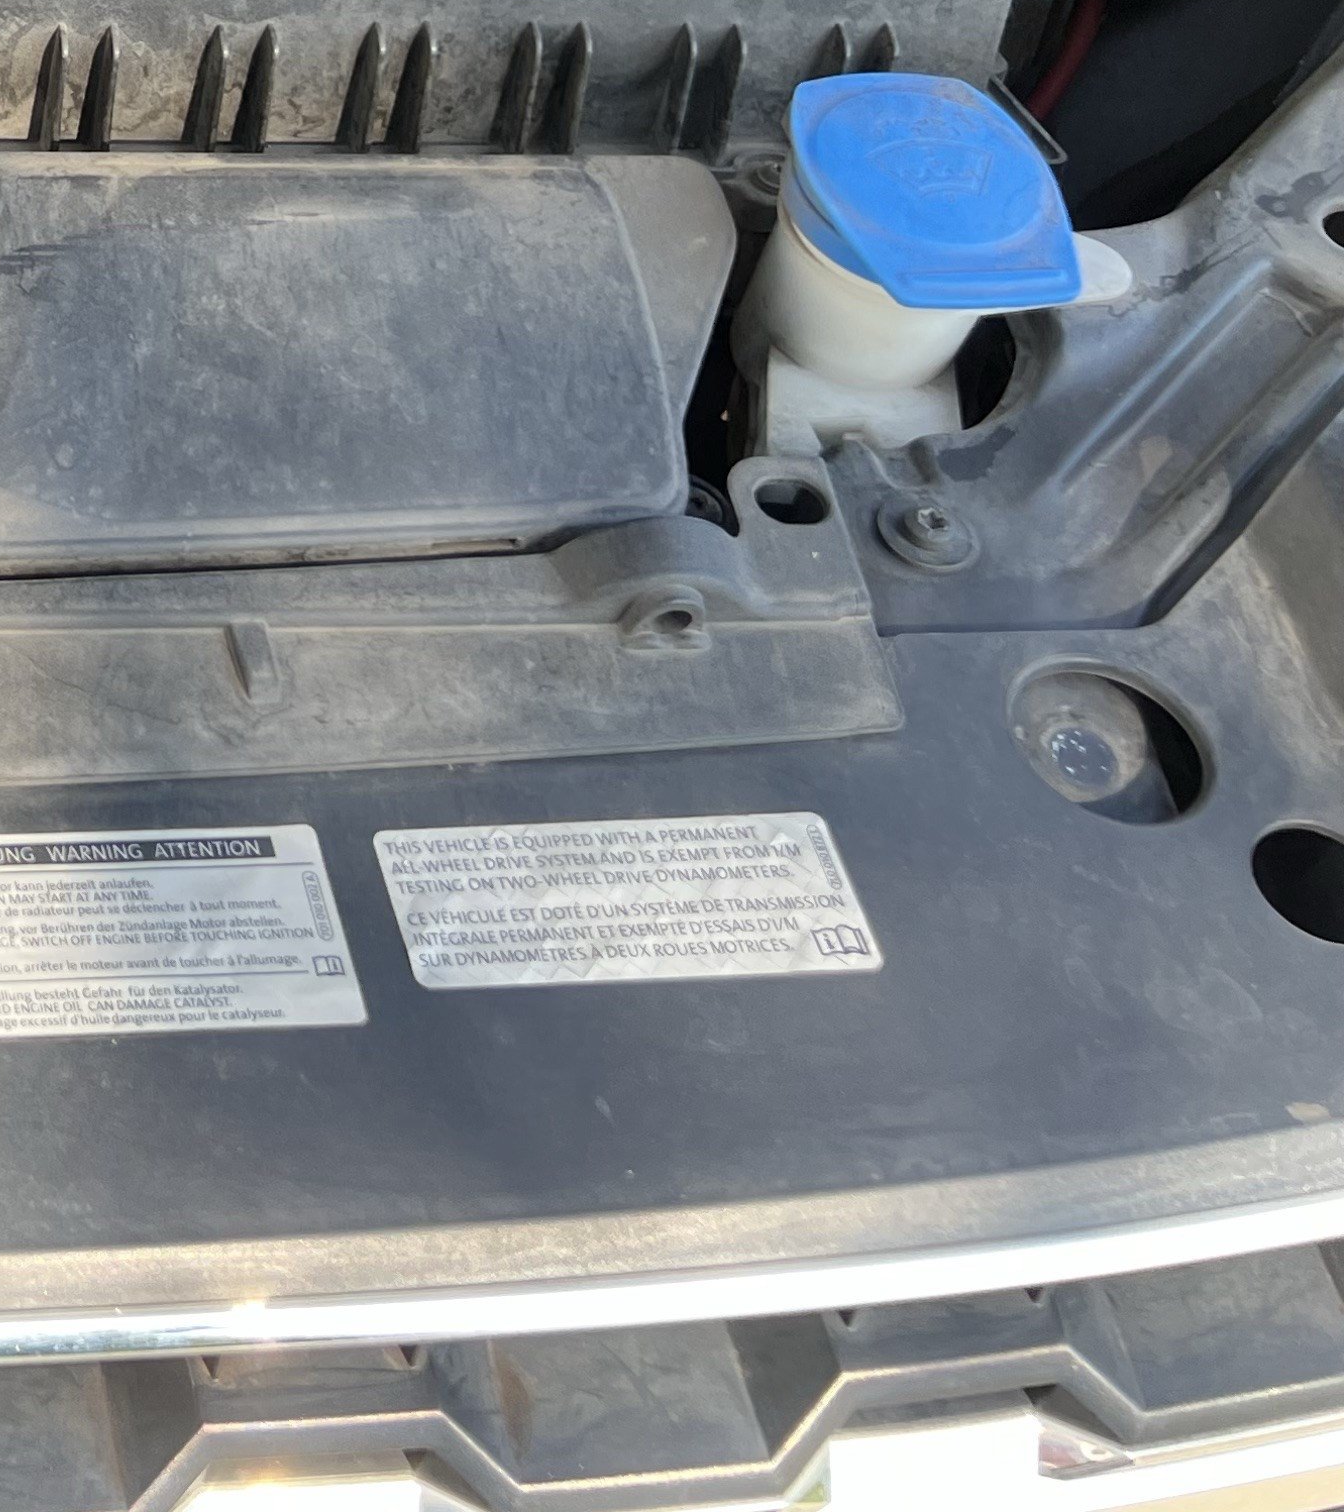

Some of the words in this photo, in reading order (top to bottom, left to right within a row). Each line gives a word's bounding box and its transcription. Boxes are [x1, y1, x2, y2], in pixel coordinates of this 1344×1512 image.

[45, 843, 144, 863] WARNING
[154, 839, 262, 858] ATTENTION
[383, 842, 421, 855] THIS
[423, 838, 491, 854] VEHICLE
[495, 837, 509, 851] IS
[513, 833, 593, 851] EQUIPPED
[595, 831, 641, 846] WITH
[645, 830, 659, 843] A
[660, 825, 758, 843] PERMANENT
[392, 859, 481, 875] ALL-WHEEL
[484, 855, 533, 871] DRIVE
[535, 852, 597, 868] SYSTEM
[600, 851, 636, 865] AND
[639, 849, 655, 863] IS
[658, 847, 720, 862] EXEMPT
[723, 844, 770, 859] FROM
[396, 879, 464, 894] TESTING
[468, 877, 494, 891] ON
[497, 872, 601, 890] TWO-WHEEL
[603, 869, 652, 885] DRIVE
[655, 864, 795, 883] DYNAMOMETERS.
[8, 893, 36, 905] MAY
[39, 892, 72, 904] START
[75, 891, 89, 903] AT
[93, 890, 118, 902] ANY
[406, 912, 428, 927] CE
[510, 908, 535, 922] EST
[701, 898, 724, 913] DE
[724, 895, 845, 912] TRANSMISSION
[22, 935, 69, 948] SWITCH
[71, 934, 93, 947] OFF
[95, 933, 141, 946] ENGINE
[144, 931, 188, 944] BEFORE
[191, 929, 256, 942] TOUCHING
[258, 927, 314, 940] IGNITION
[499, 925, 594, 944] PERMANENT
[597, 925, 616, 939] ET
[418, 952, 454, 968] SUR
[604, 943, 651, 958] DEUX
[653, 941, 708, 957] ROUES
[710, 938, 796, 955] MOTRICES.
[13, 1002, 60, 1015] ENGINE
[88, 999, 113, 1011] CAN
[117, 998, 171, 1011] DAMAGE
